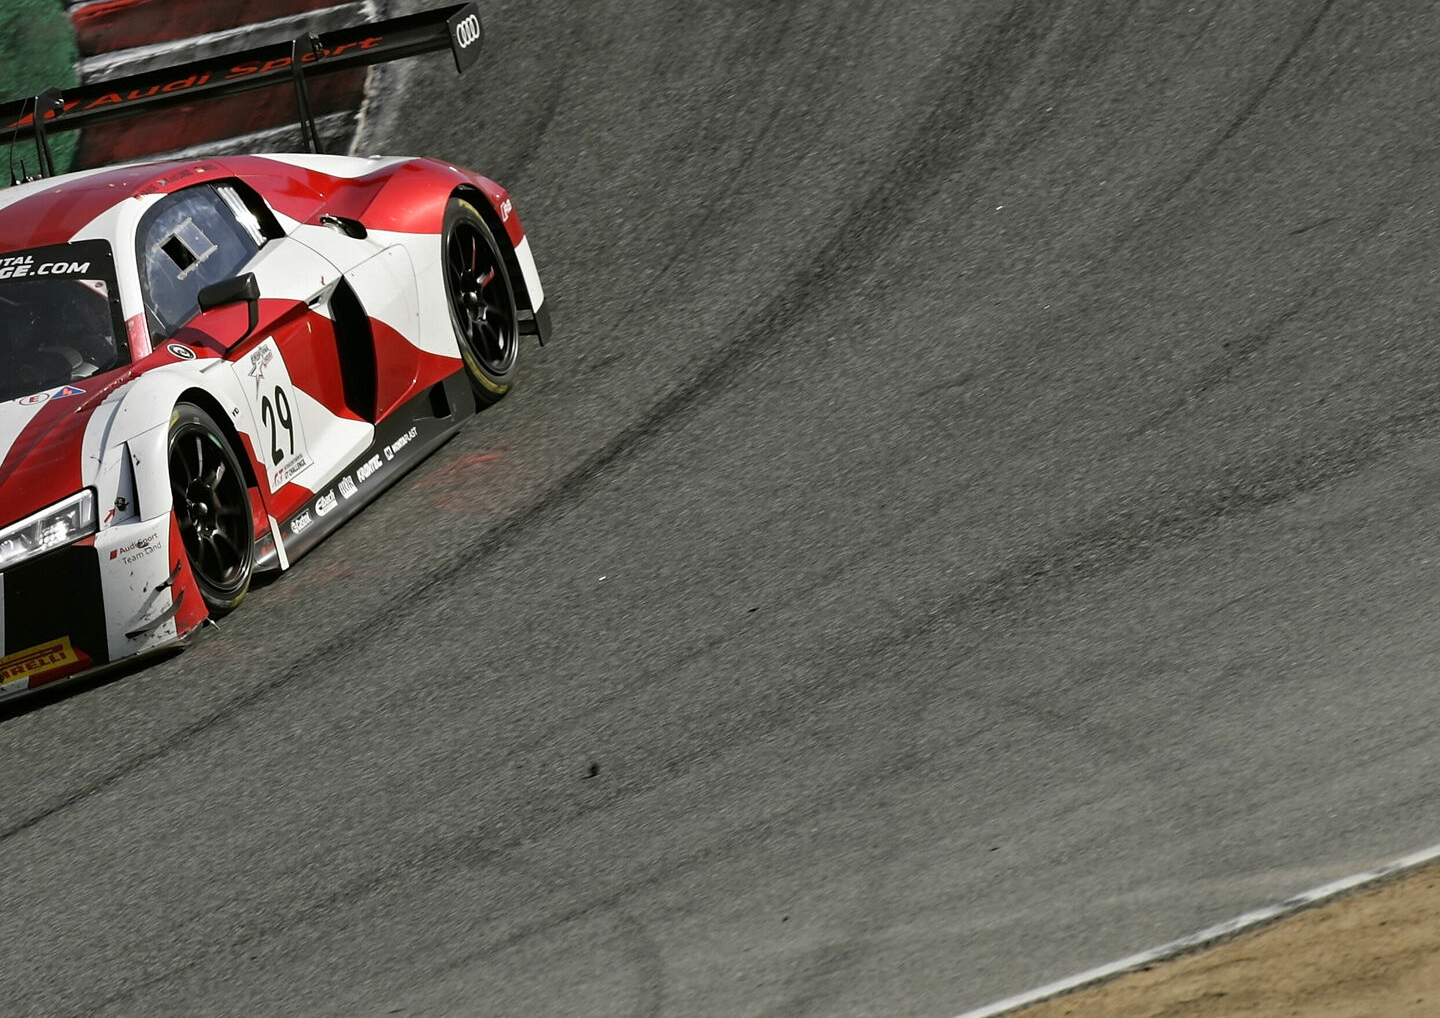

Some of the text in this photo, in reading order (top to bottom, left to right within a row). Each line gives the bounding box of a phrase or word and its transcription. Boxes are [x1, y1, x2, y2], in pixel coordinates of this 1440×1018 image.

[93, 36, 384, 108] Audi Sport
[262, 384, 294, 467] 29
[122, 553, 145, 565] Team
